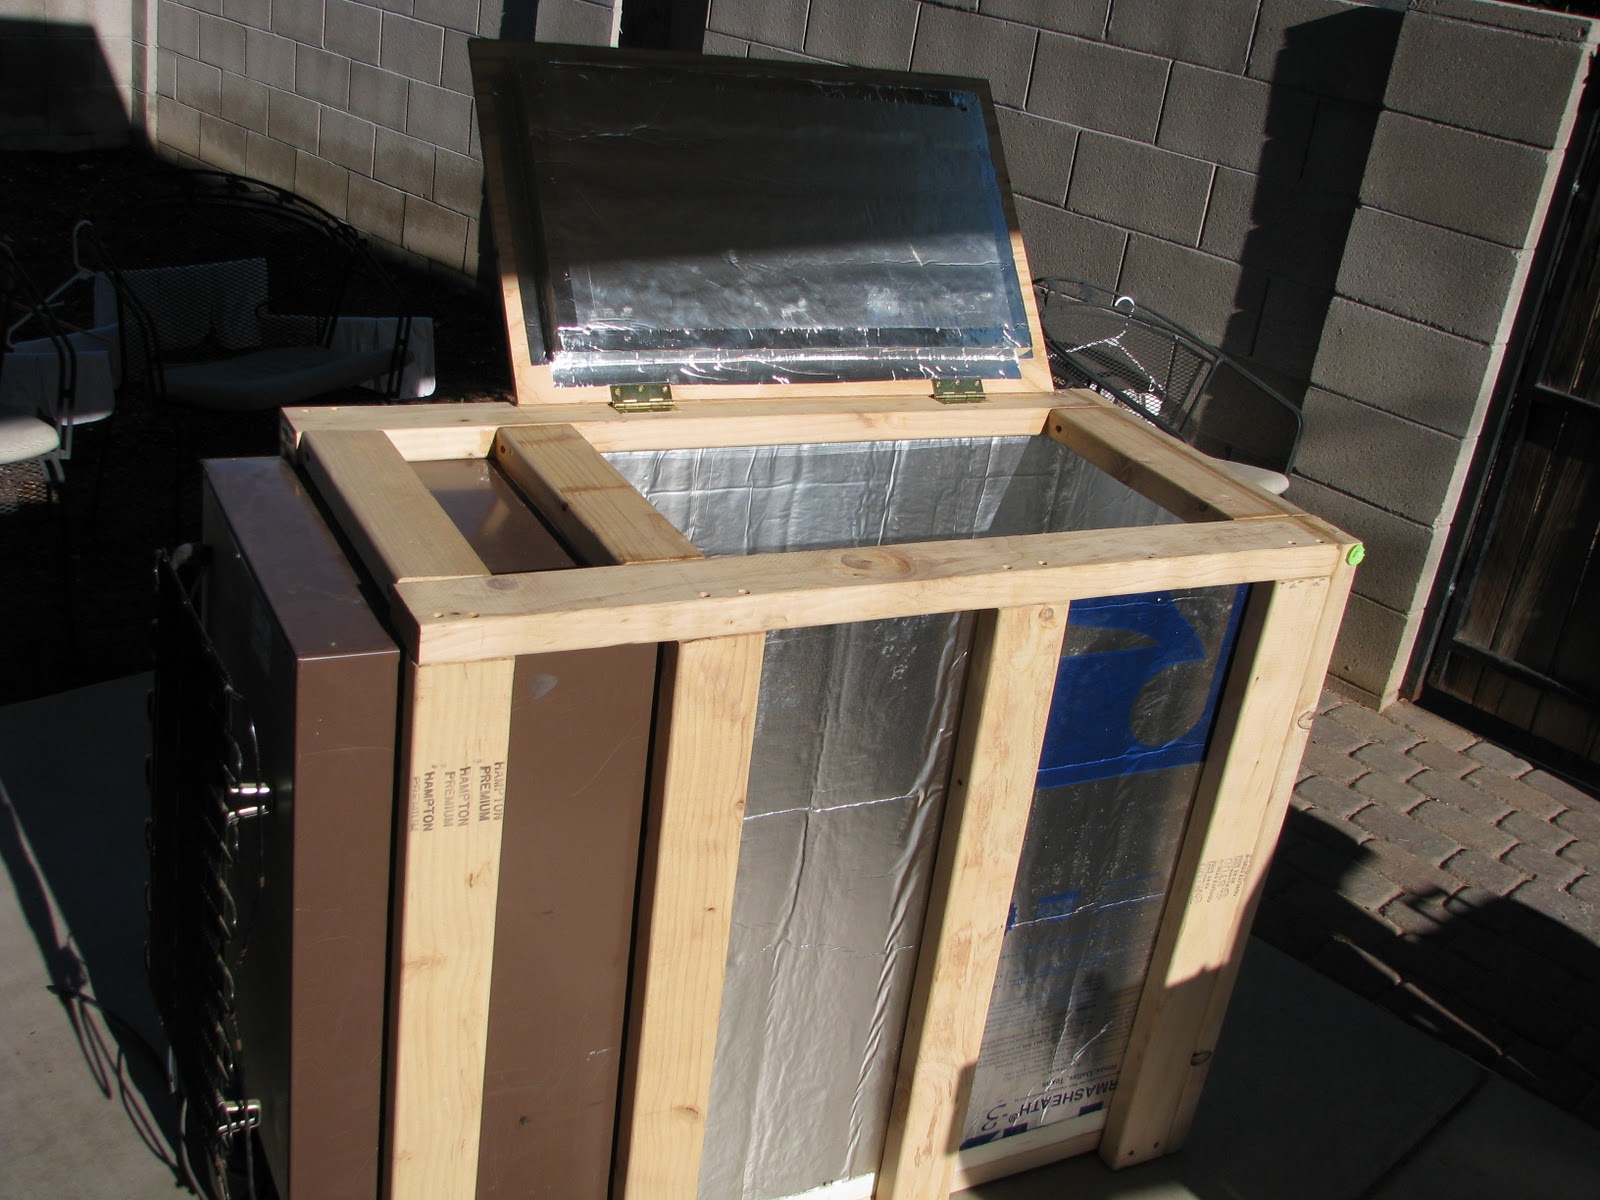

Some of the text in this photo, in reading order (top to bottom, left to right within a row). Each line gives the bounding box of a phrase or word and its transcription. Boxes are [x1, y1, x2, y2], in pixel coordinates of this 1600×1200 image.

[423, 771, 436, 832] HAMPTON
[443, 771, 456, 828] PREMIUM
[458, 766, 471, 827] HAMPTON
[479, 765, 491, 822] PREMIUM
[493, 761, 504, 820] HAMPTON
